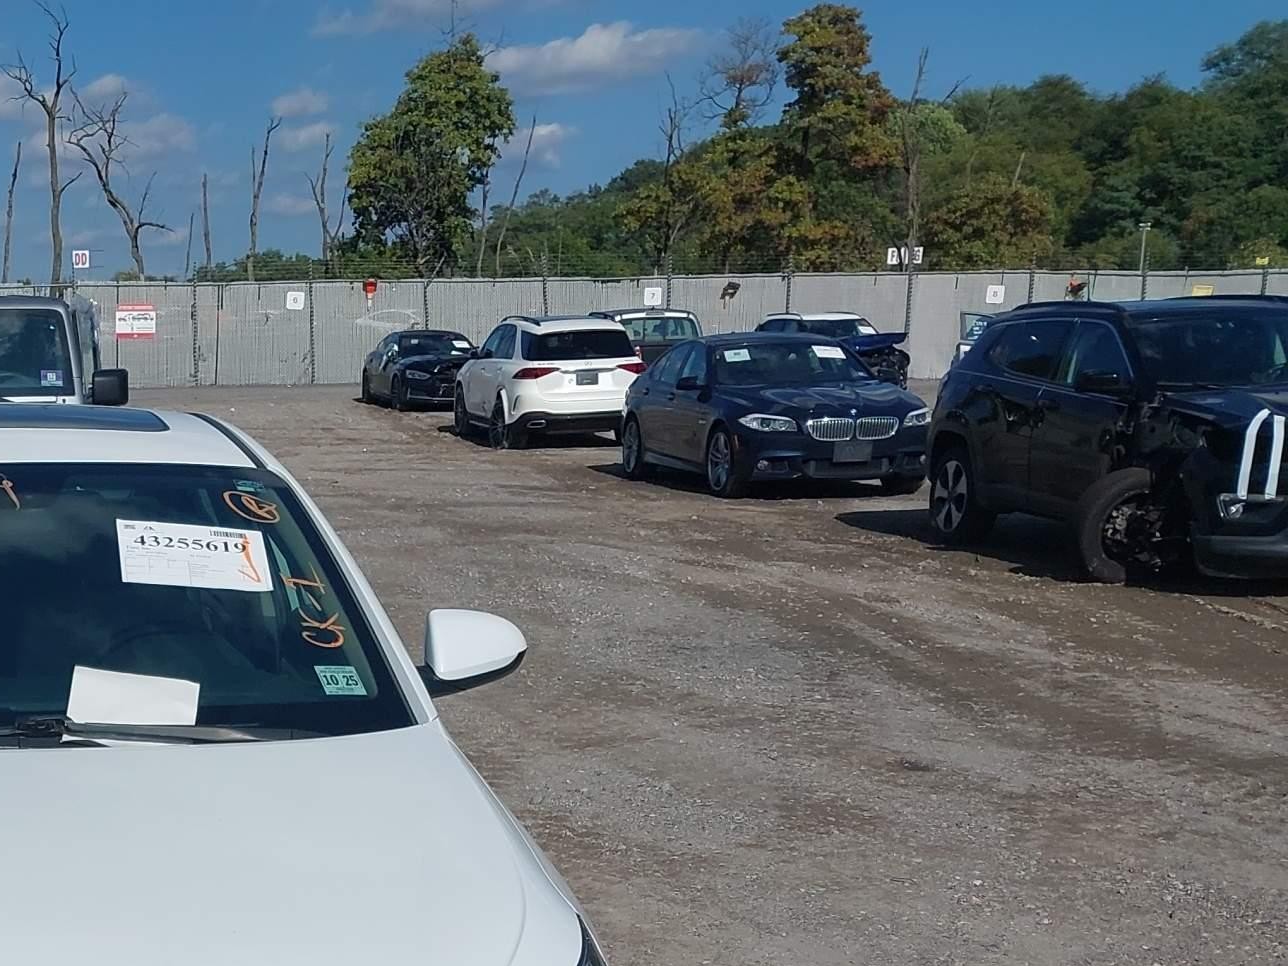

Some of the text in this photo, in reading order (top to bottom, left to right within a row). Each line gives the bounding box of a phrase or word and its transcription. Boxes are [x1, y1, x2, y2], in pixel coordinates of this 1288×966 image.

[74, 252, 88, 267] DD
[134, 534, 247, 554] 43255619
[322, 674, 359, 686] 10 25
